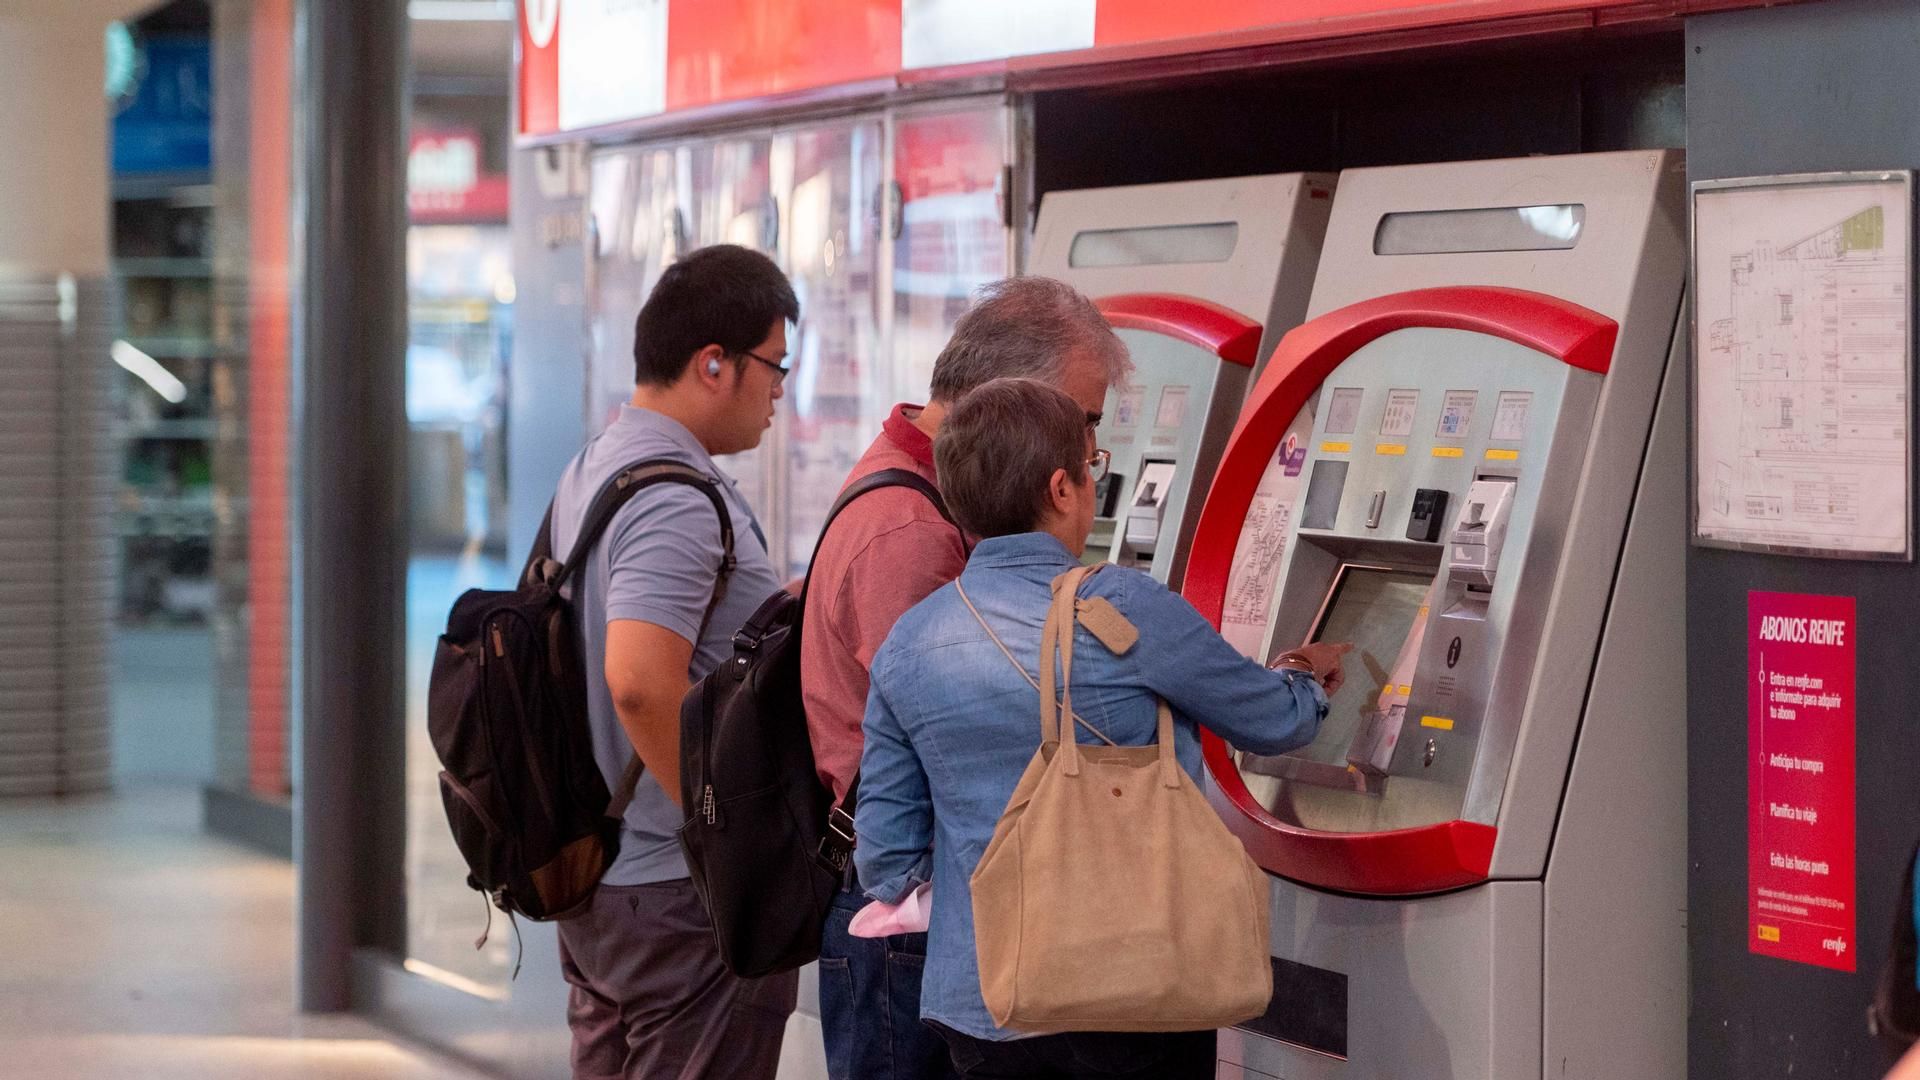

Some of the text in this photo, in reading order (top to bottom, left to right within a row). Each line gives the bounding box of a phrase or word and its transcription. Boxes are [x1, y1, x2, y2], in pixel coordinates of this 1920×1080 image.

[1759, 615, 1846, 646] ABONOS RENFE
[1770, 671, 1823, 691] Entra en renfe.com
[1770, 688, 1842, 710] e infórmate para adquirir
[1770, 705, 1796, 720] tu abono
[1770, 753, 1824, 776] Anticipa tu compra
[1770, 802, 1817, 826] Planifica tu viaje
[1770, 852, 1829, 876] Evita las horas punta
[1823, 936, 1846, 956] renfe
